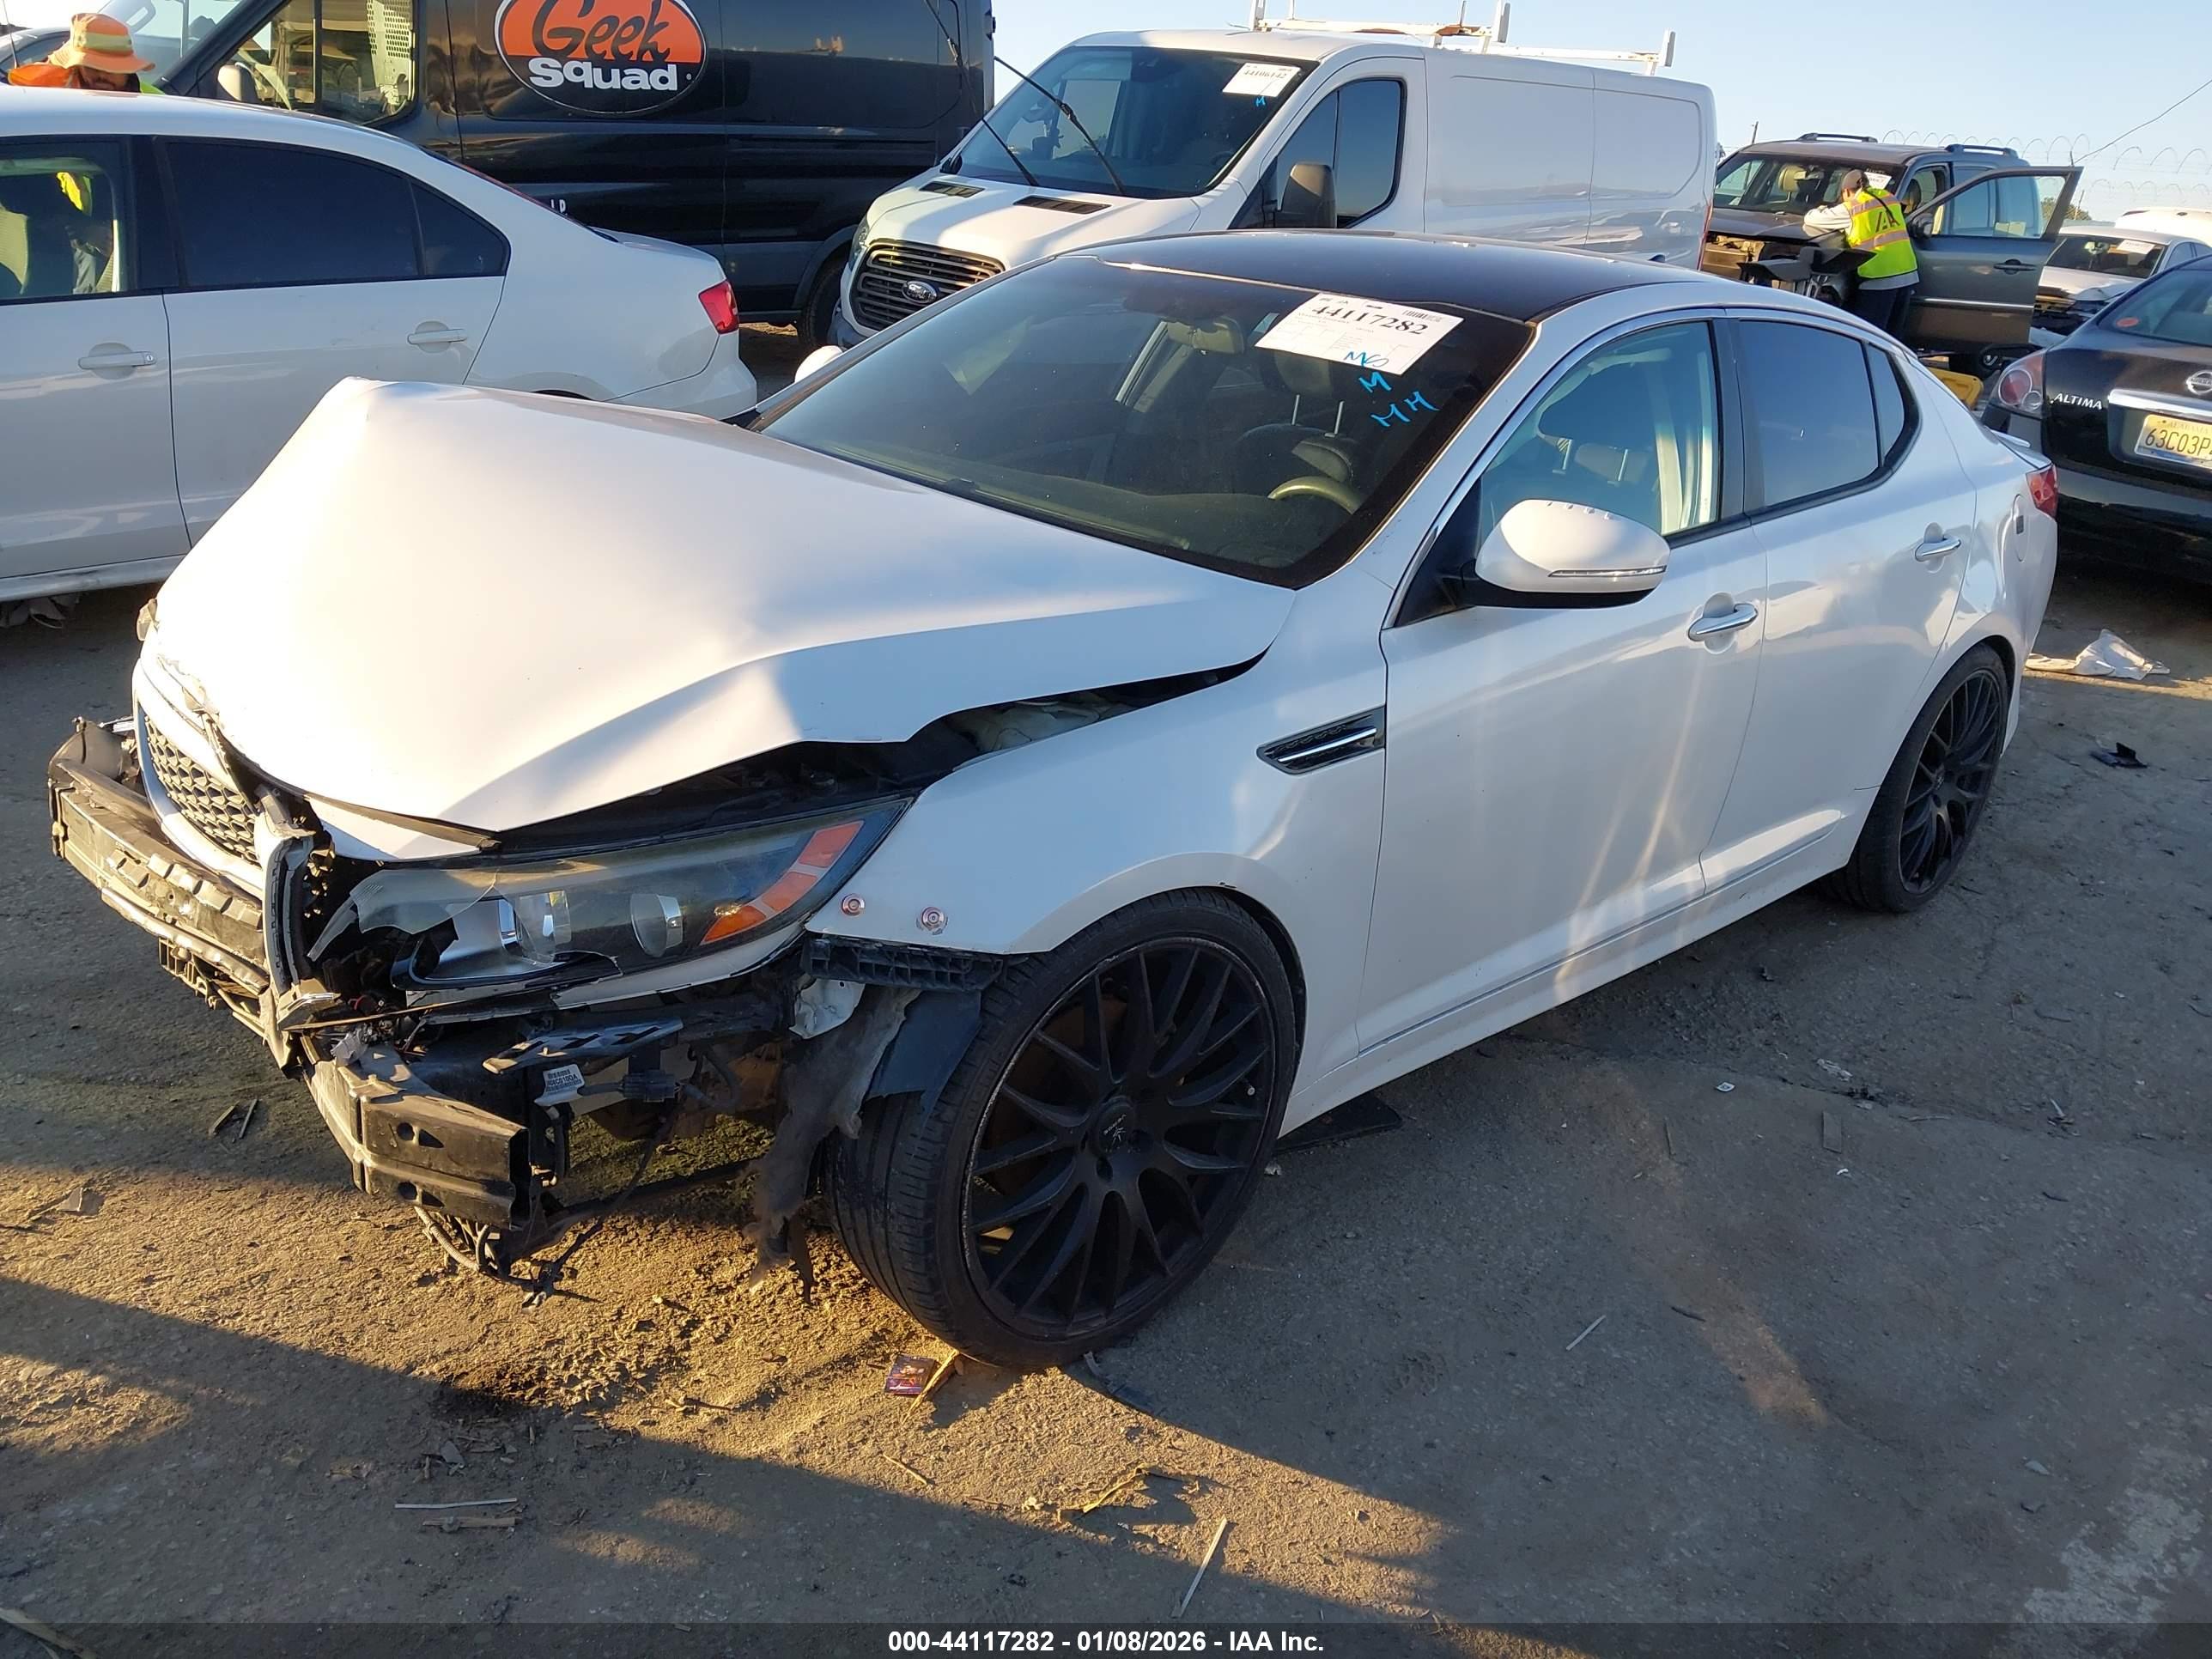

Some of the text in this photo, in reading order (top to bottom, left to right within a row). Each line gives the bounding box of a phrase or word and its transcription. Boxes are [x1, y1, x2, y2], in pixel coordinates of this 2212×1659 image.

[532, 0, 671, 62] Geek
[528, 57, 678, 91] Squad
[1312, 306, 1428, 334] 44117282
[2051, 392, 2102, 410] ALTIMA
[2145, 428, 2212, 456] 63C03P
